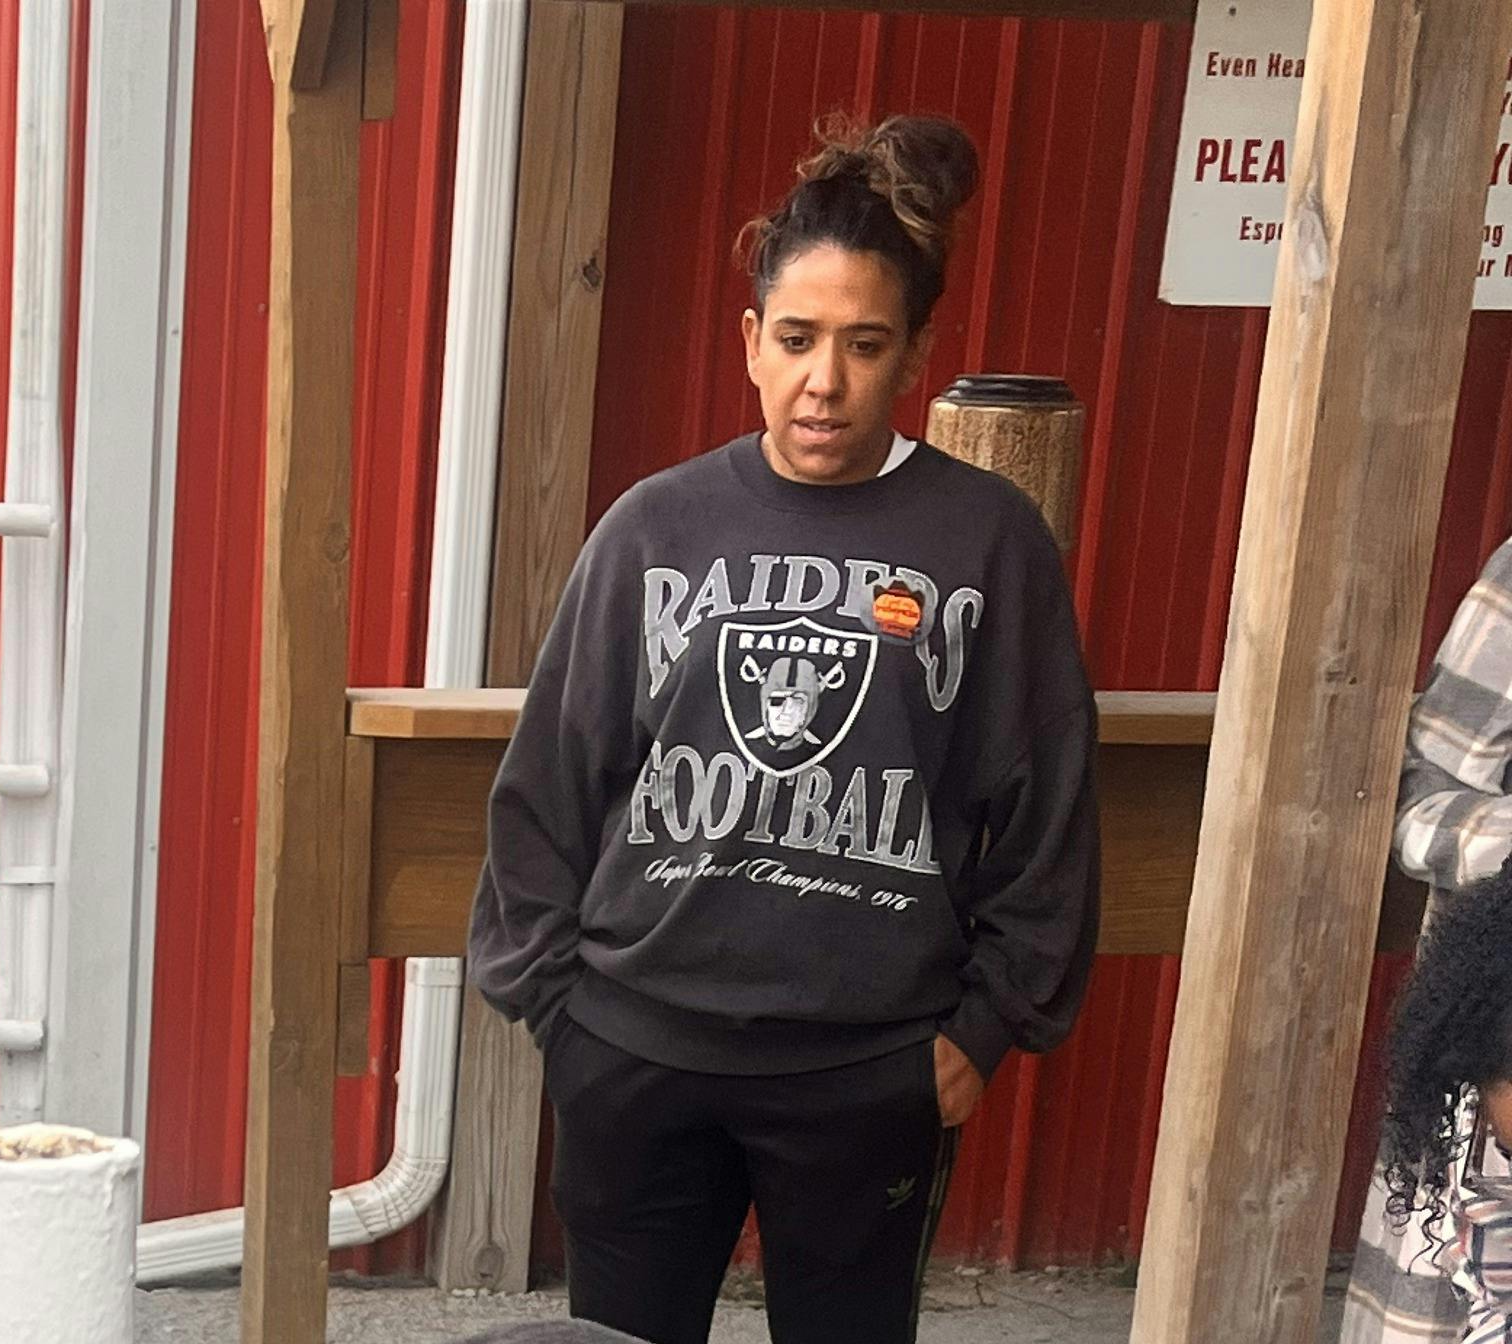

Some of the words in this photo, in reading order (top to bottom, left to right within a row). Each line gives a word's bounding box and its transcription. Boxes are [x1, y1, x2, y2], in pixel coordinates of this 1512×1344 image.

[1206, 51, 1256, 77] Even
[738, 631, 858, 658] RAIDERS
[627, 740, 942, 875] FOOTBALL
